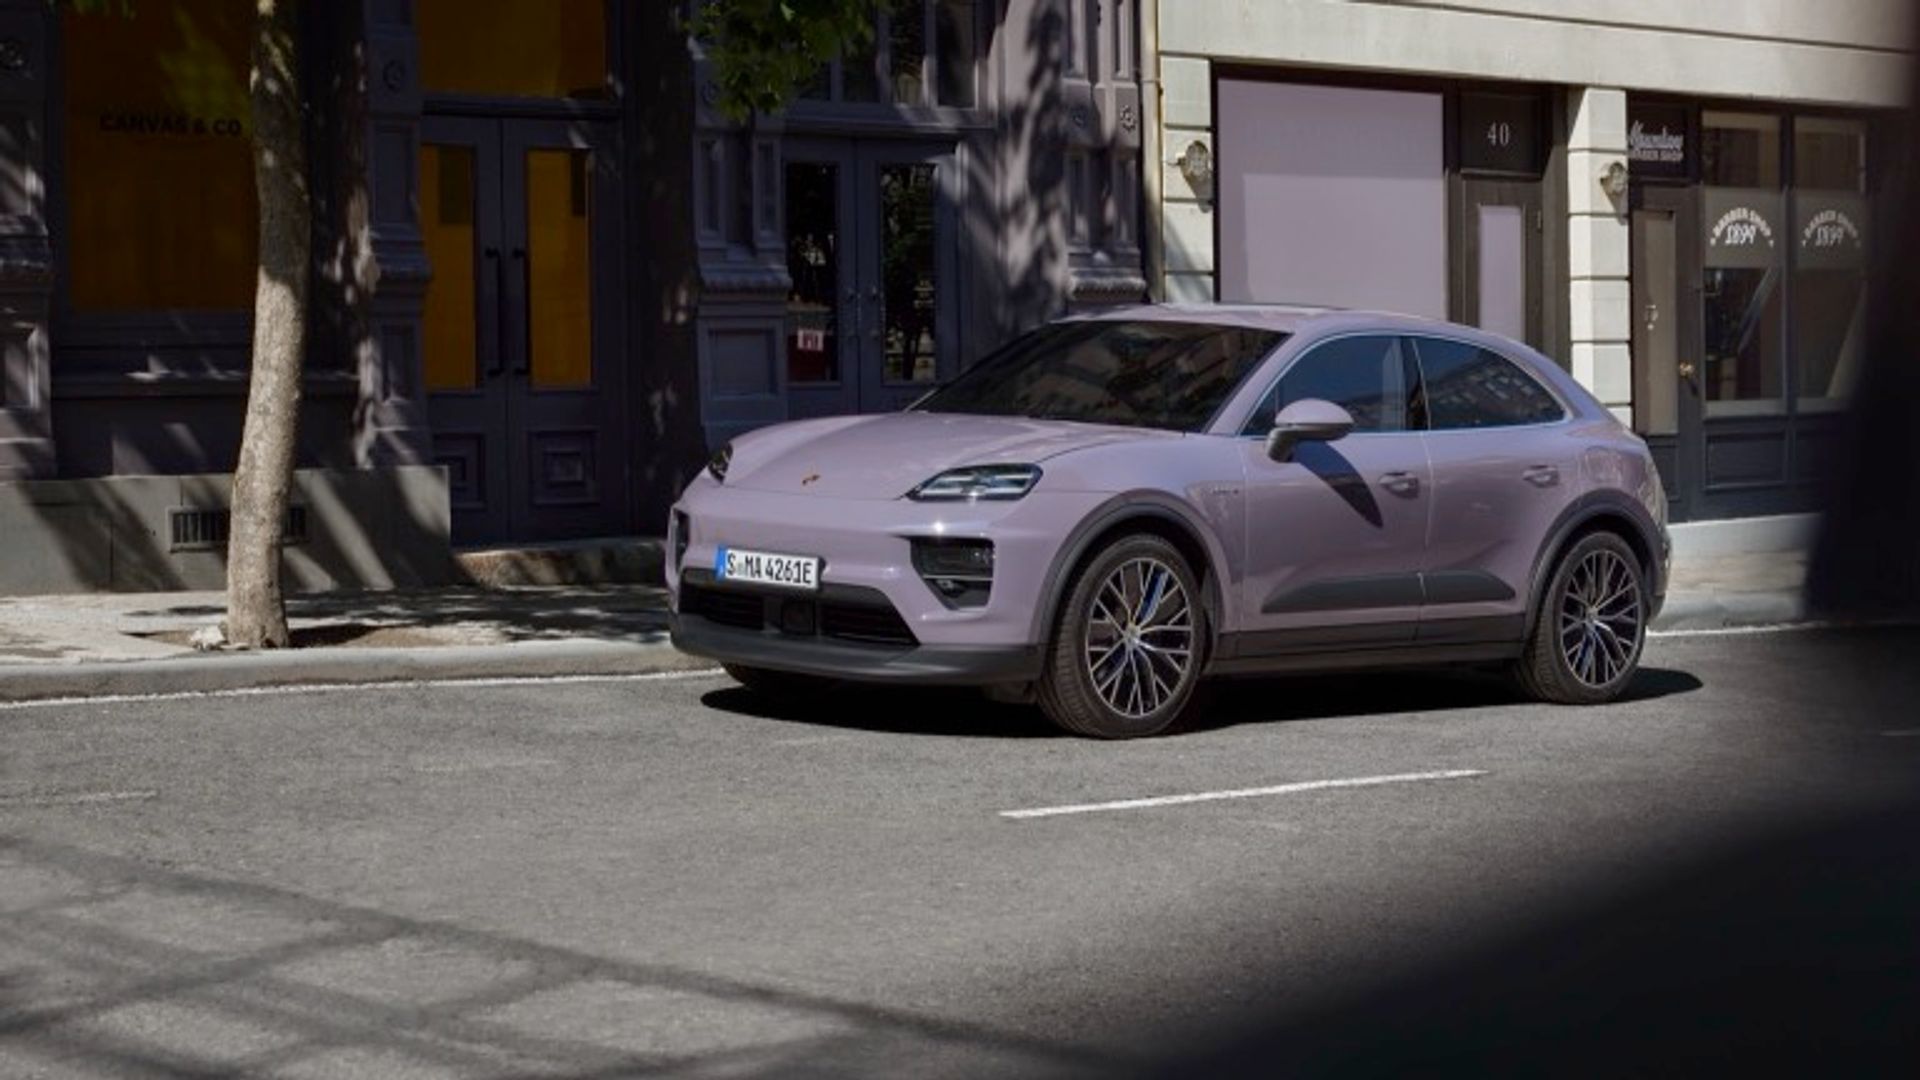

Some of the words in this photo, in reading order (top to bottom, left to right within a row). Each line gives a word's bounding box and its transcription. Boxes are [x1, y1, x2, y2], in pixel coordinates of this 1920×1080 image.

[98, 112, 190, 135] CANVAS
[193, 117, 207, 135] &
[1487, 121, 1510, 147] 40
[1712, 207, 1749, 237] BARBER
[726, 552, 737, 576] S
[745, 555, 762, 579] MA
[765, 558, 813, 585] 4261E
